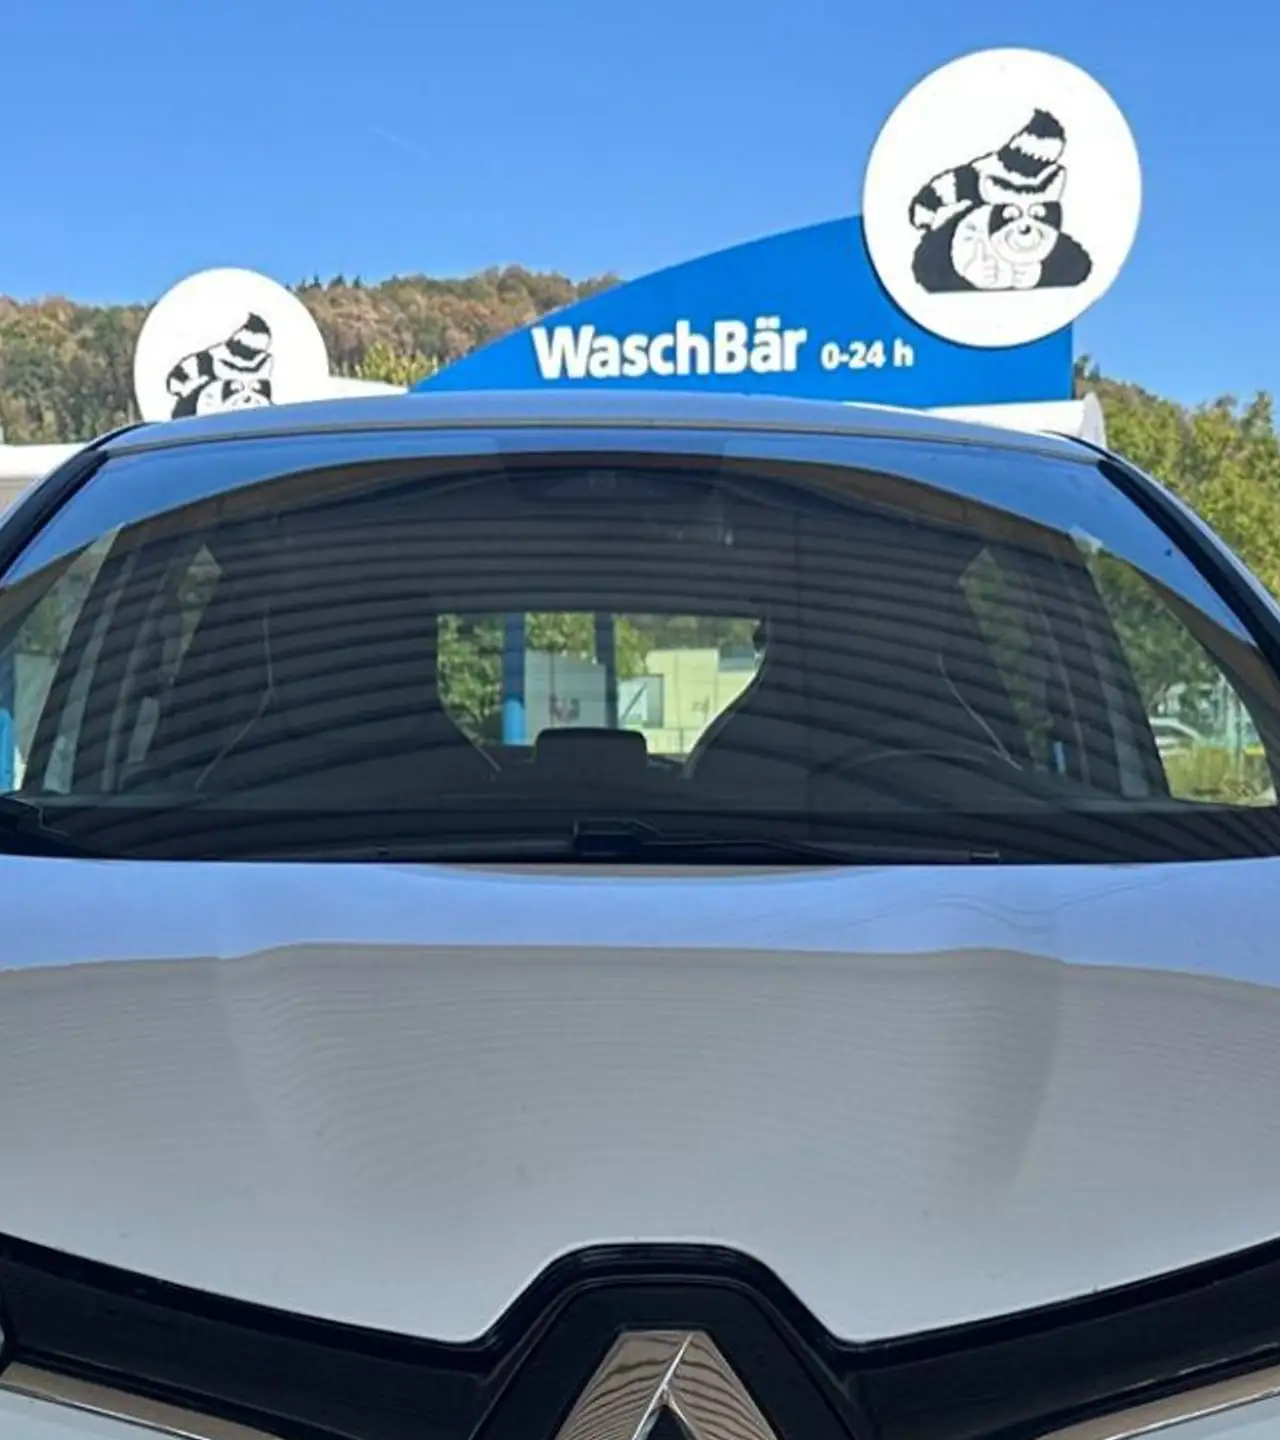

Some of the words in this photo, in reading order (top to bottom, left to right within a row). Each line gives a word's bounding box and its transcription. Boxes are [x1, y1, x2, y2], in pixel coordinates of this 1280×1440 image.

[531, 316, 807, 379] WaschBär
[821, 341, 885, 369] 0-24
[893, 338, 914, 367] h
